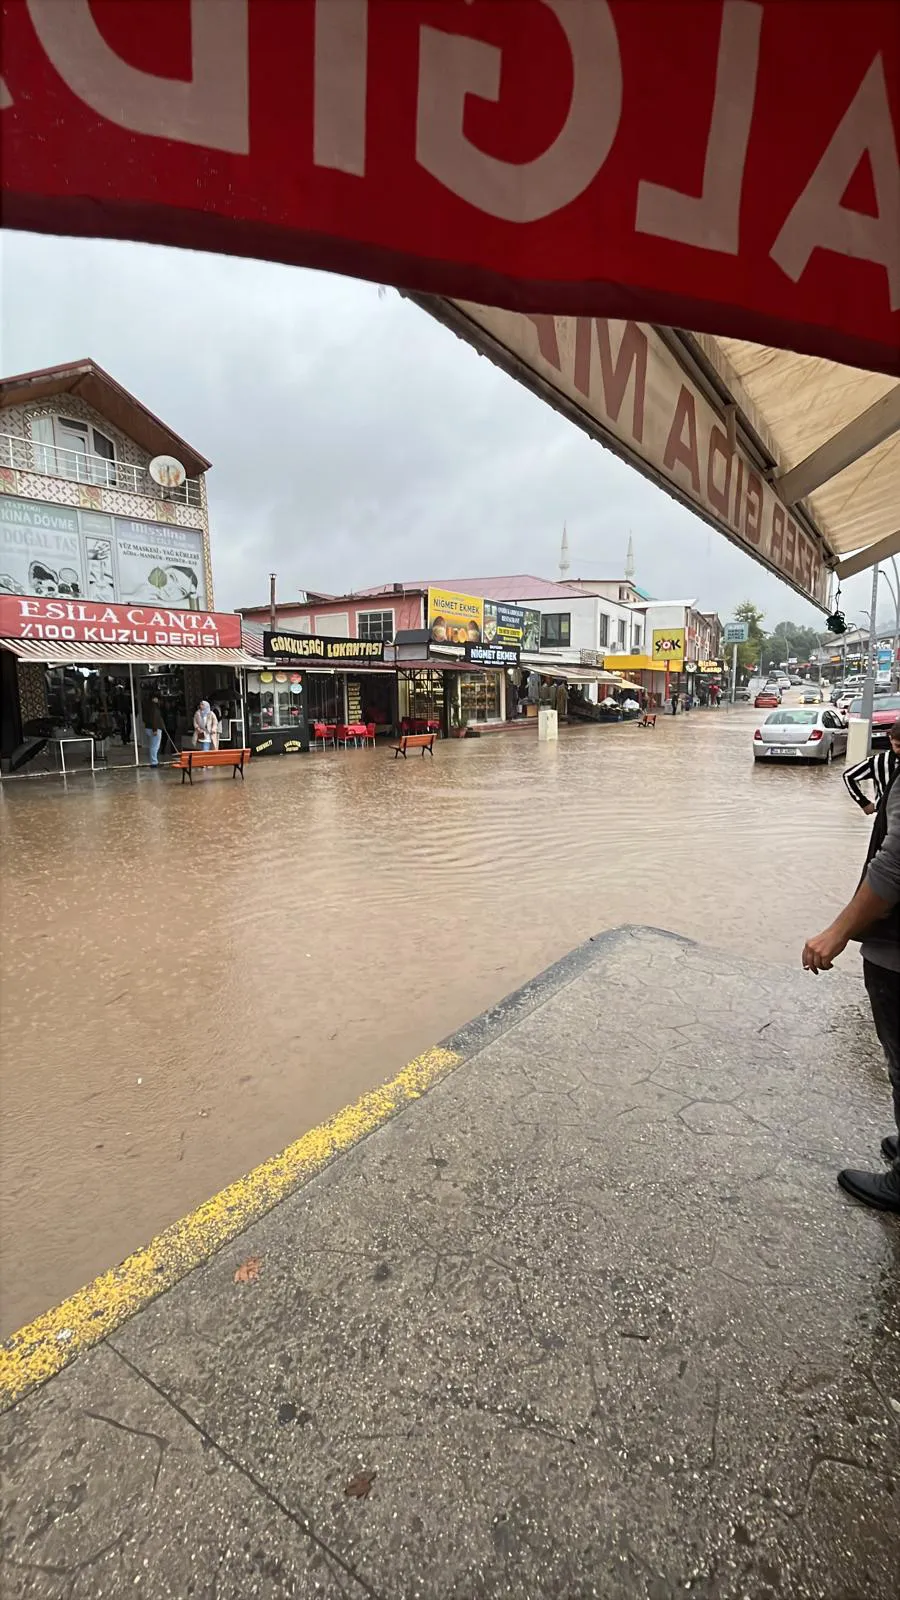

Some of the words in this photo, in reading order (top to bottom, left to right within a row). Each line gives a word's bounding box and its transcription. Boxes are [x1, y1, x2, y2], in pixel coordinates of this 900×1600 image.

[18, 600, 120, 624] ESİLA
[20, 623, 76, 639] %100
[84, 627, 149, 643] KUZU
[155, 631, 220, 647] DERİSİ
[327, 642, 383, 658] LOKANTASI
[496, 650, 518, 662] EKMEK
